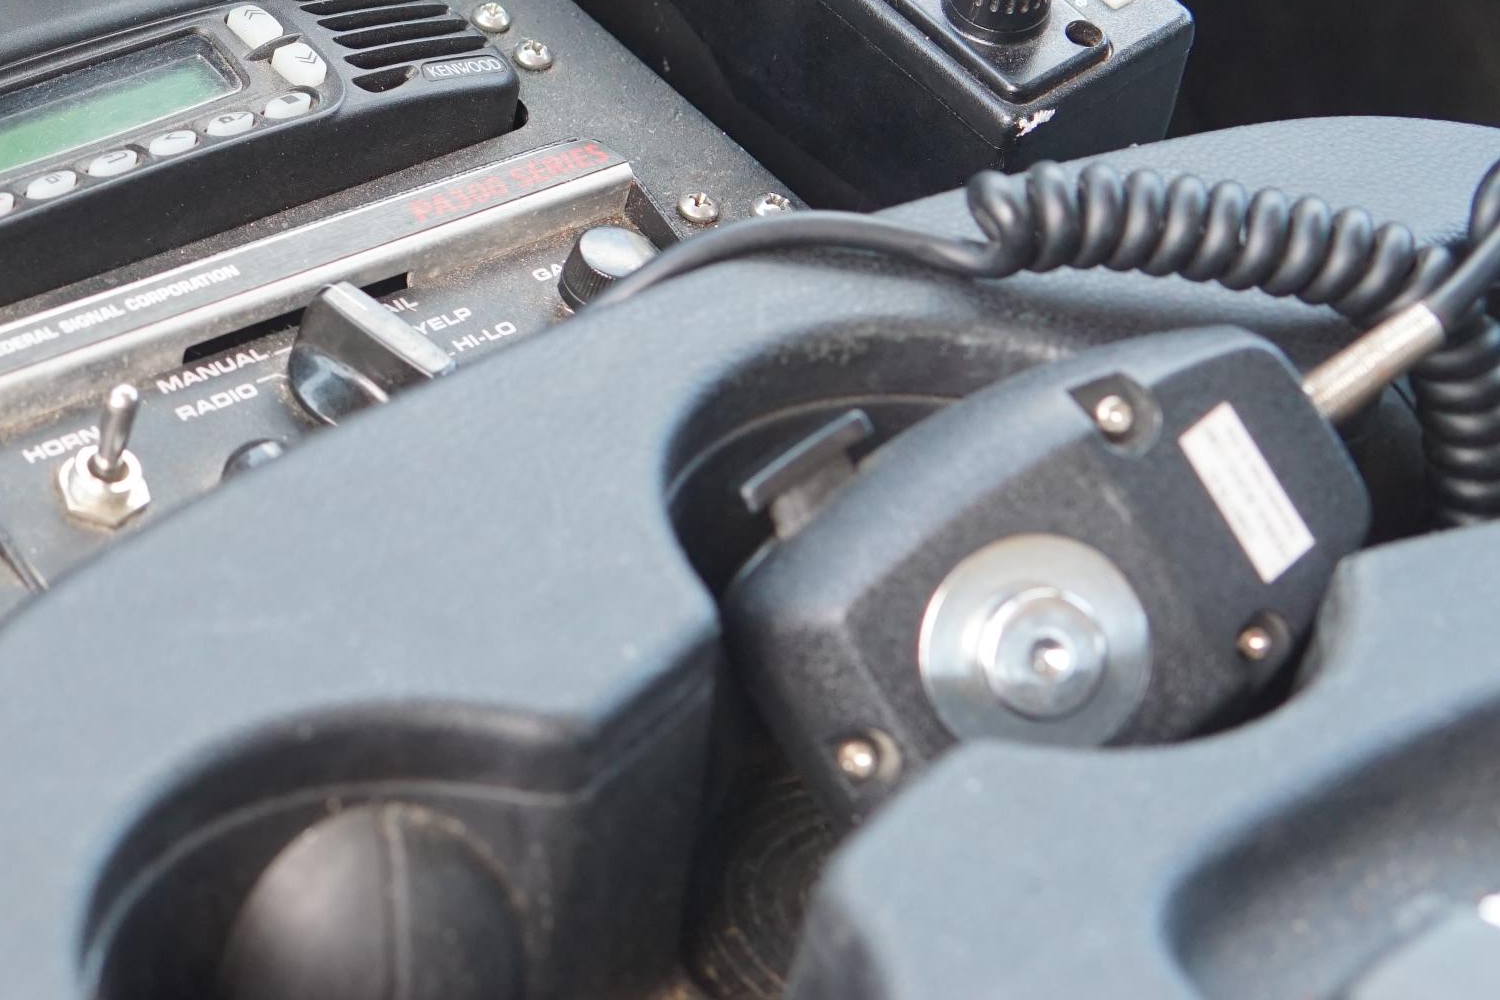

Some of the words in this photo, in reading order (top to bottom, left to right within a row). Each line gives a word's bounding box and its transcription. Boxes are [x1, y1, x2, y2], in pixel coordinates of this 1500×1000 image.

[426, 58, 503, 79] KENWOOD
[509, 143, 610, 189] SERIES
[61, 303, 126, 336] SIGNAL
[123, 263, 242, 313] CORPORATION
[382, 296, 420, 314] AIL
[412, 306, 473, 336] YELP
[451, 320, 517, 352] HI-LO
[155, 347, 271, 395] MANUAL
[174, 382, 259, 422] RADIO
[21, 424, 100, 465] HORN
